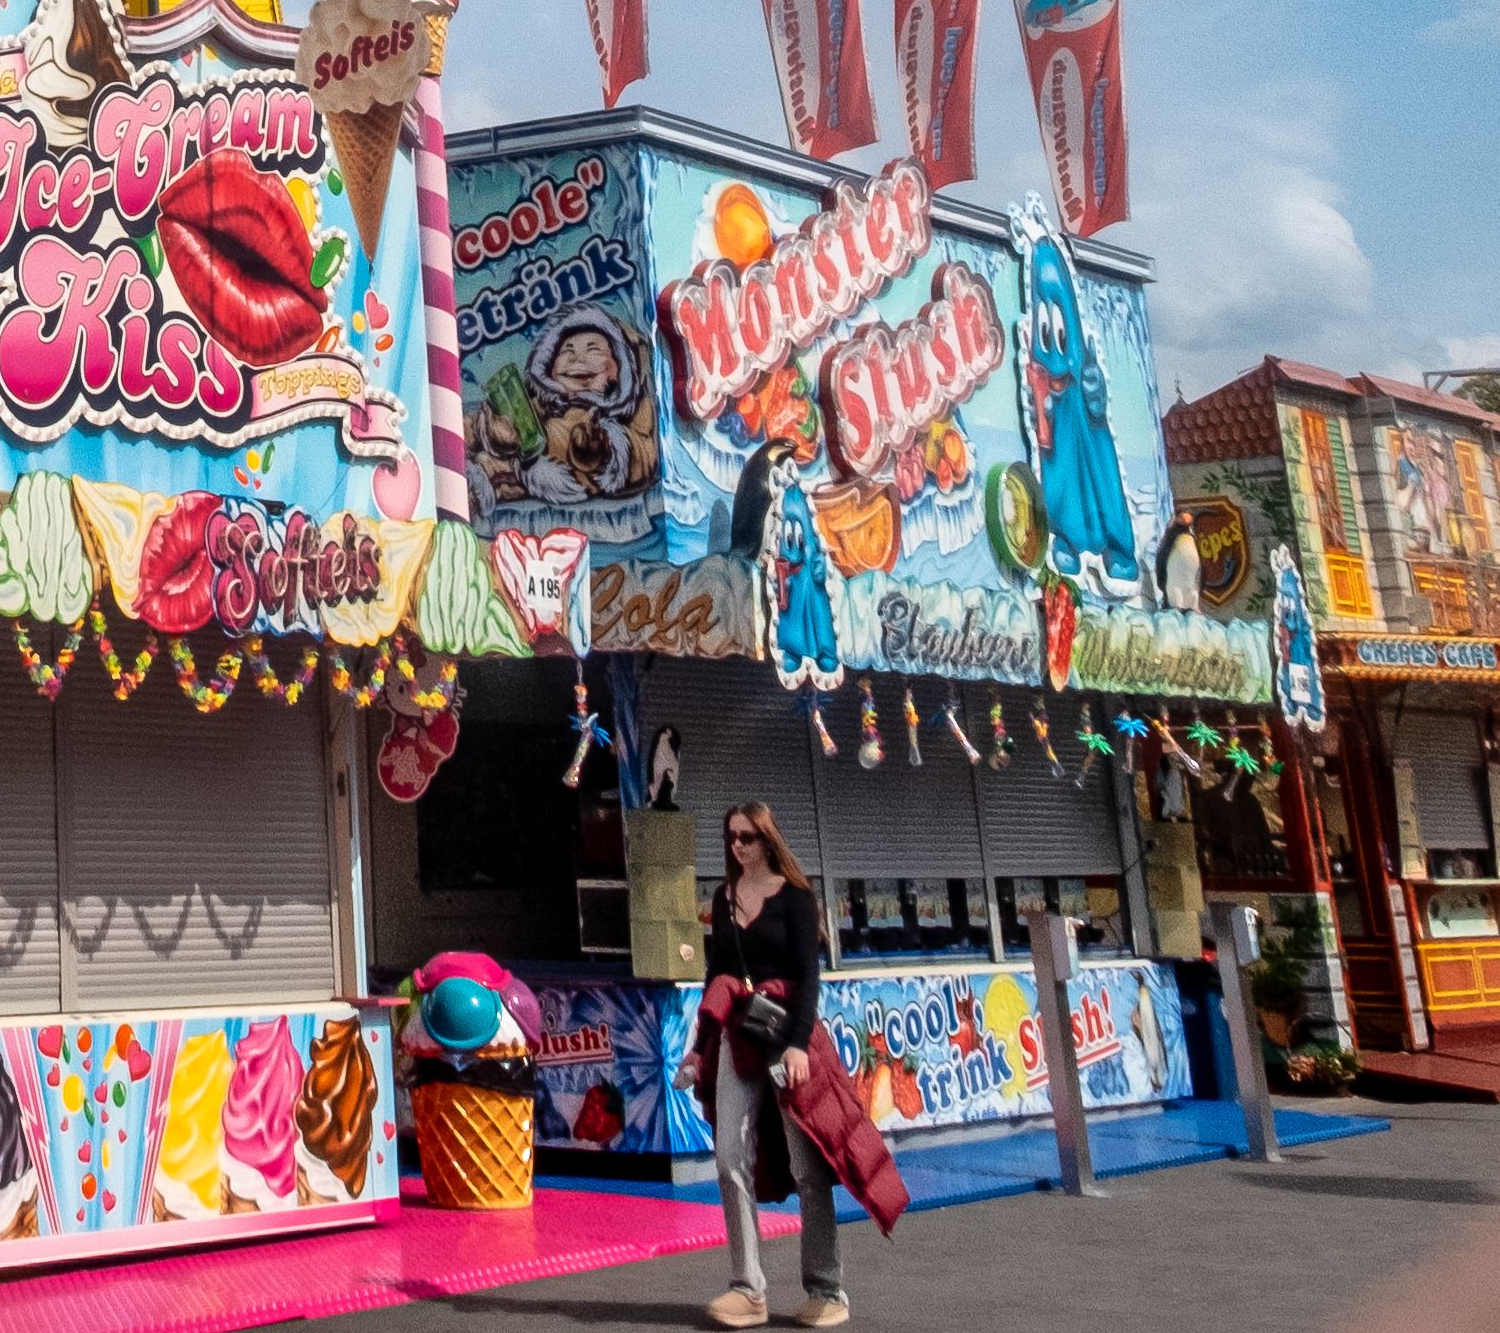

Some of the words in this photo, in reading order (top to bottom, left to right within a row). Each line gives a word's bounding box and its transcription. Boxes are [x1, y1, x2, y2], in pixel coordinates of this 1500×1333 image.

[313, 19, 415, 90] Softeis
[457, 236, 637, 351] etränk
[668, 157, 931, 421] Monster
[258, 361, 361, 402] Toppings
[828, 265, 1004, 477] Slush
[206, 510, 382, 639] Softeis
[528, 576, 536, 596] A
[541, 579, 560, 599] 195
[591, 564, 720, 643] Cola
[915, 1028, 1015, 1116] trink
[1016, 984, 1116, 1075] Ssh!
